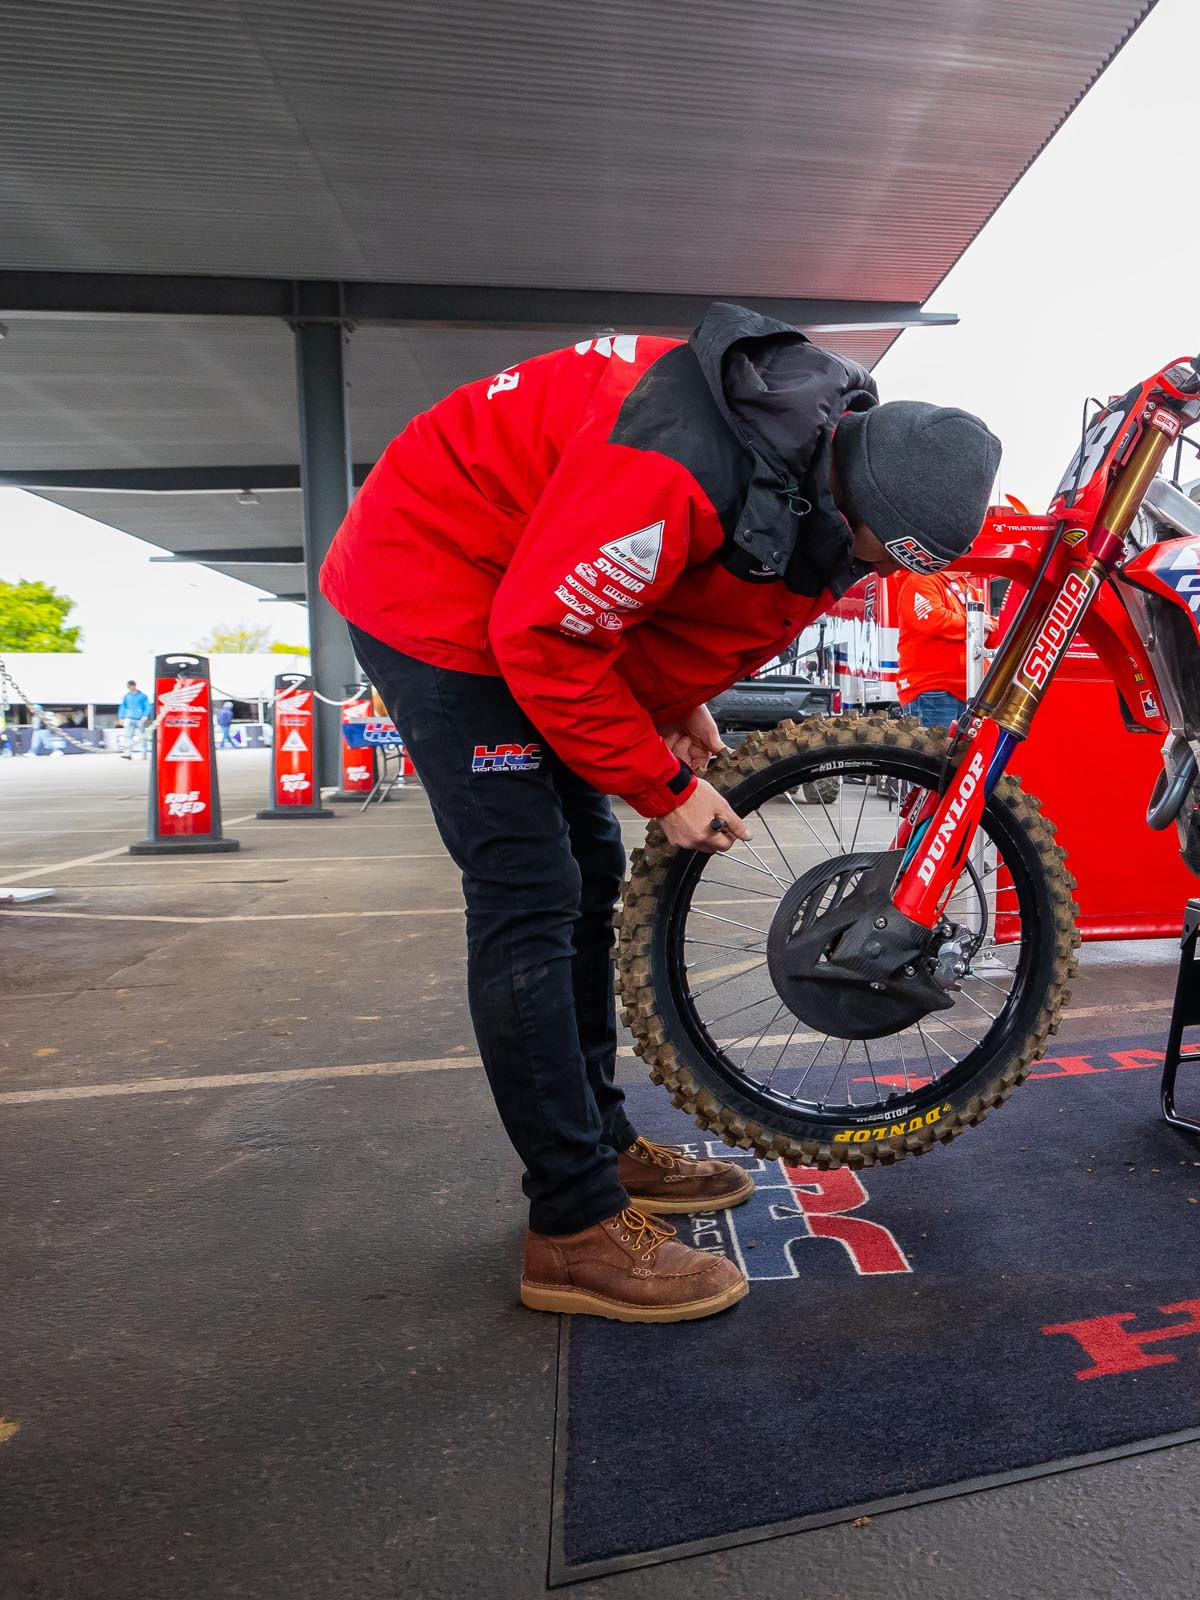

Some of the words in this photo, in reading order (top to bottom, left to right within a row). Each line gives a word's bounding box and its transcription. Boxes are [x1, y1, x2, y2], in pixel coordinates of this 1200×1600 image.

[1156, 414, 1178, 430] GET
[610, 546, 627, 559] Pro
[626, 556, 651, 575] Honda
[593, 557, 646, 593] SHOWA
[603, 585, 643, 608] HINSON
[565, 618, 589, 632] GET
[1023, 572, 1090, 690] SHOWA
[727, 695, 794, 707] HONDA
[472, 744, 542, 768] HRC
[165, 791, 200, 804] RIDE
[168, 801, 206, 817] RED
[917, 752, 983, 887] DUNLOP
[834, 1106, 941, 1143] DUNLOP
